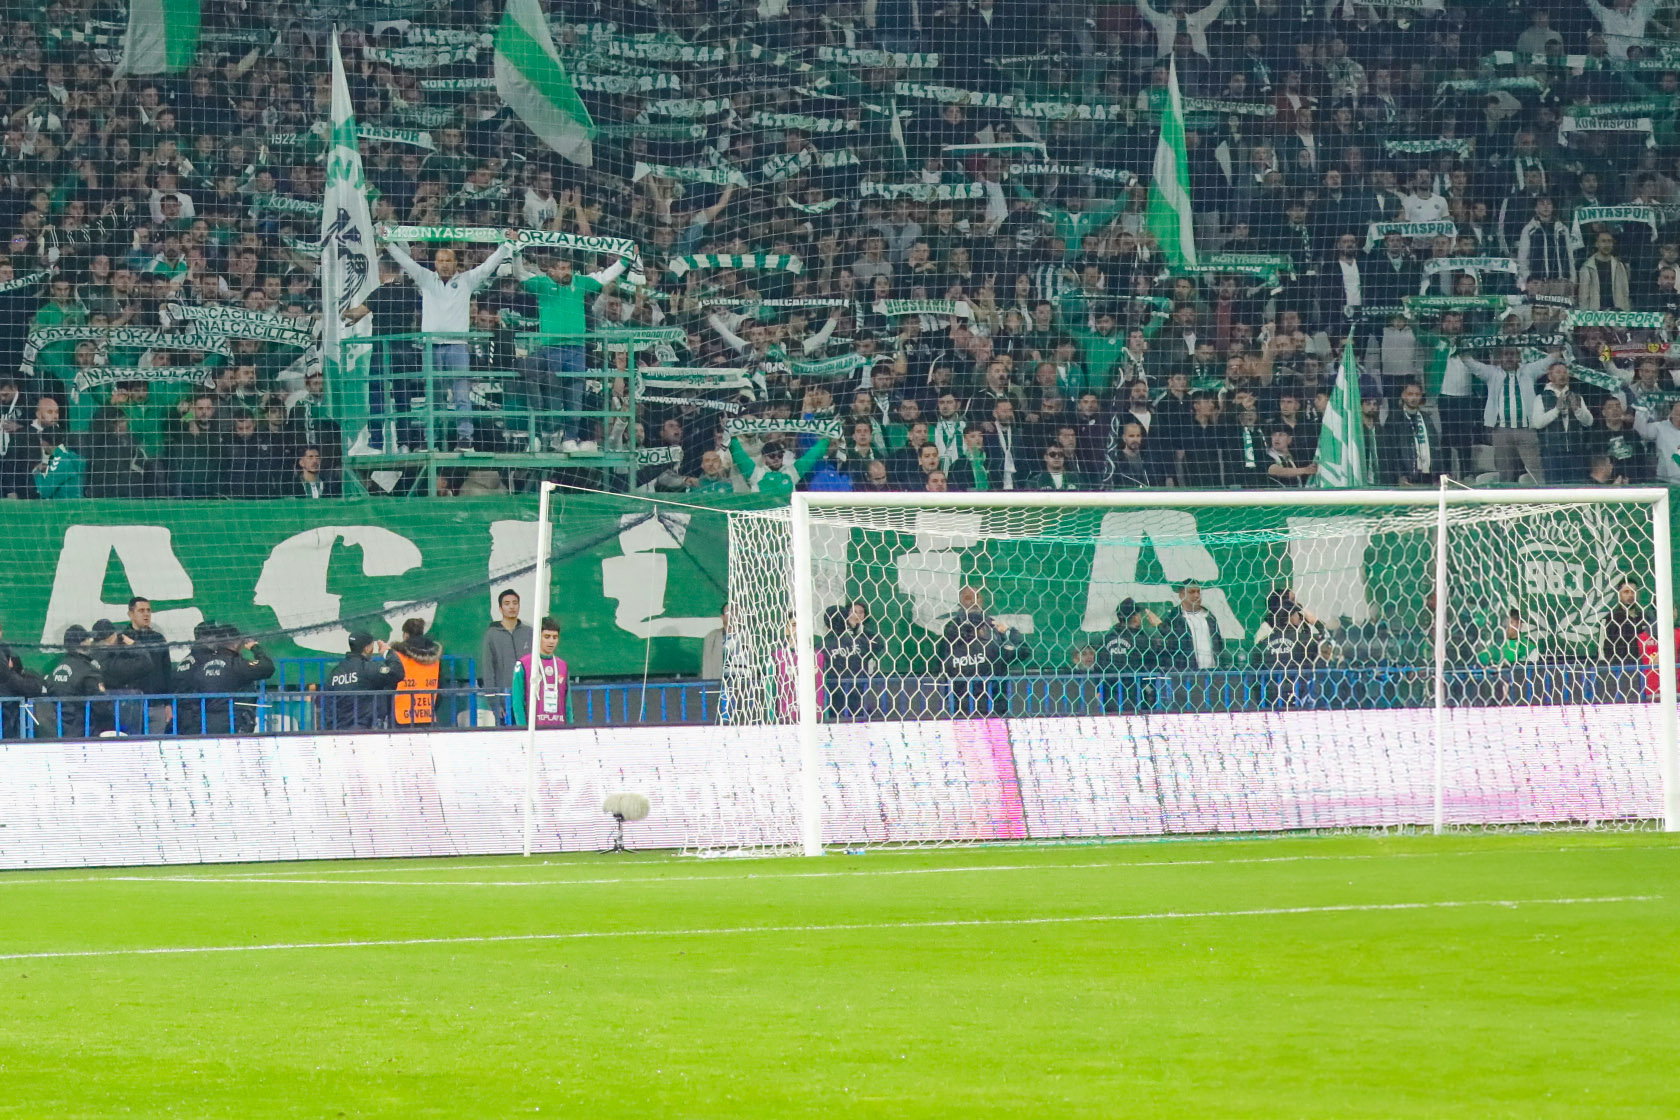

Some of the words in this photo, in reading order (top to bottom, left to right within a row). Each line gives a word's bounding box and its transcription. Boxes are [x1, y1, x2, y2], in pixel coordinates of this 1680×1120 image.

[270, 133, 297, 145] 1922
[1578, 205, 1650, 223] ONYASPOR
[397, 227, 497, 241] KONYASPOR
[1376, 222, 1453, 237] KONYASPOR
[518, 229, 560, 245] ORZA
[563, 232, 635, 258] KONYA
[1576, 312, 1651, 325] KONYASPOR
[109, 329, 166, 347] FORZA
[171, 331, 230, 355] KONYA
[725, 419, 778, 436] FORZA
[784, 418, 842, 436] KONYA
